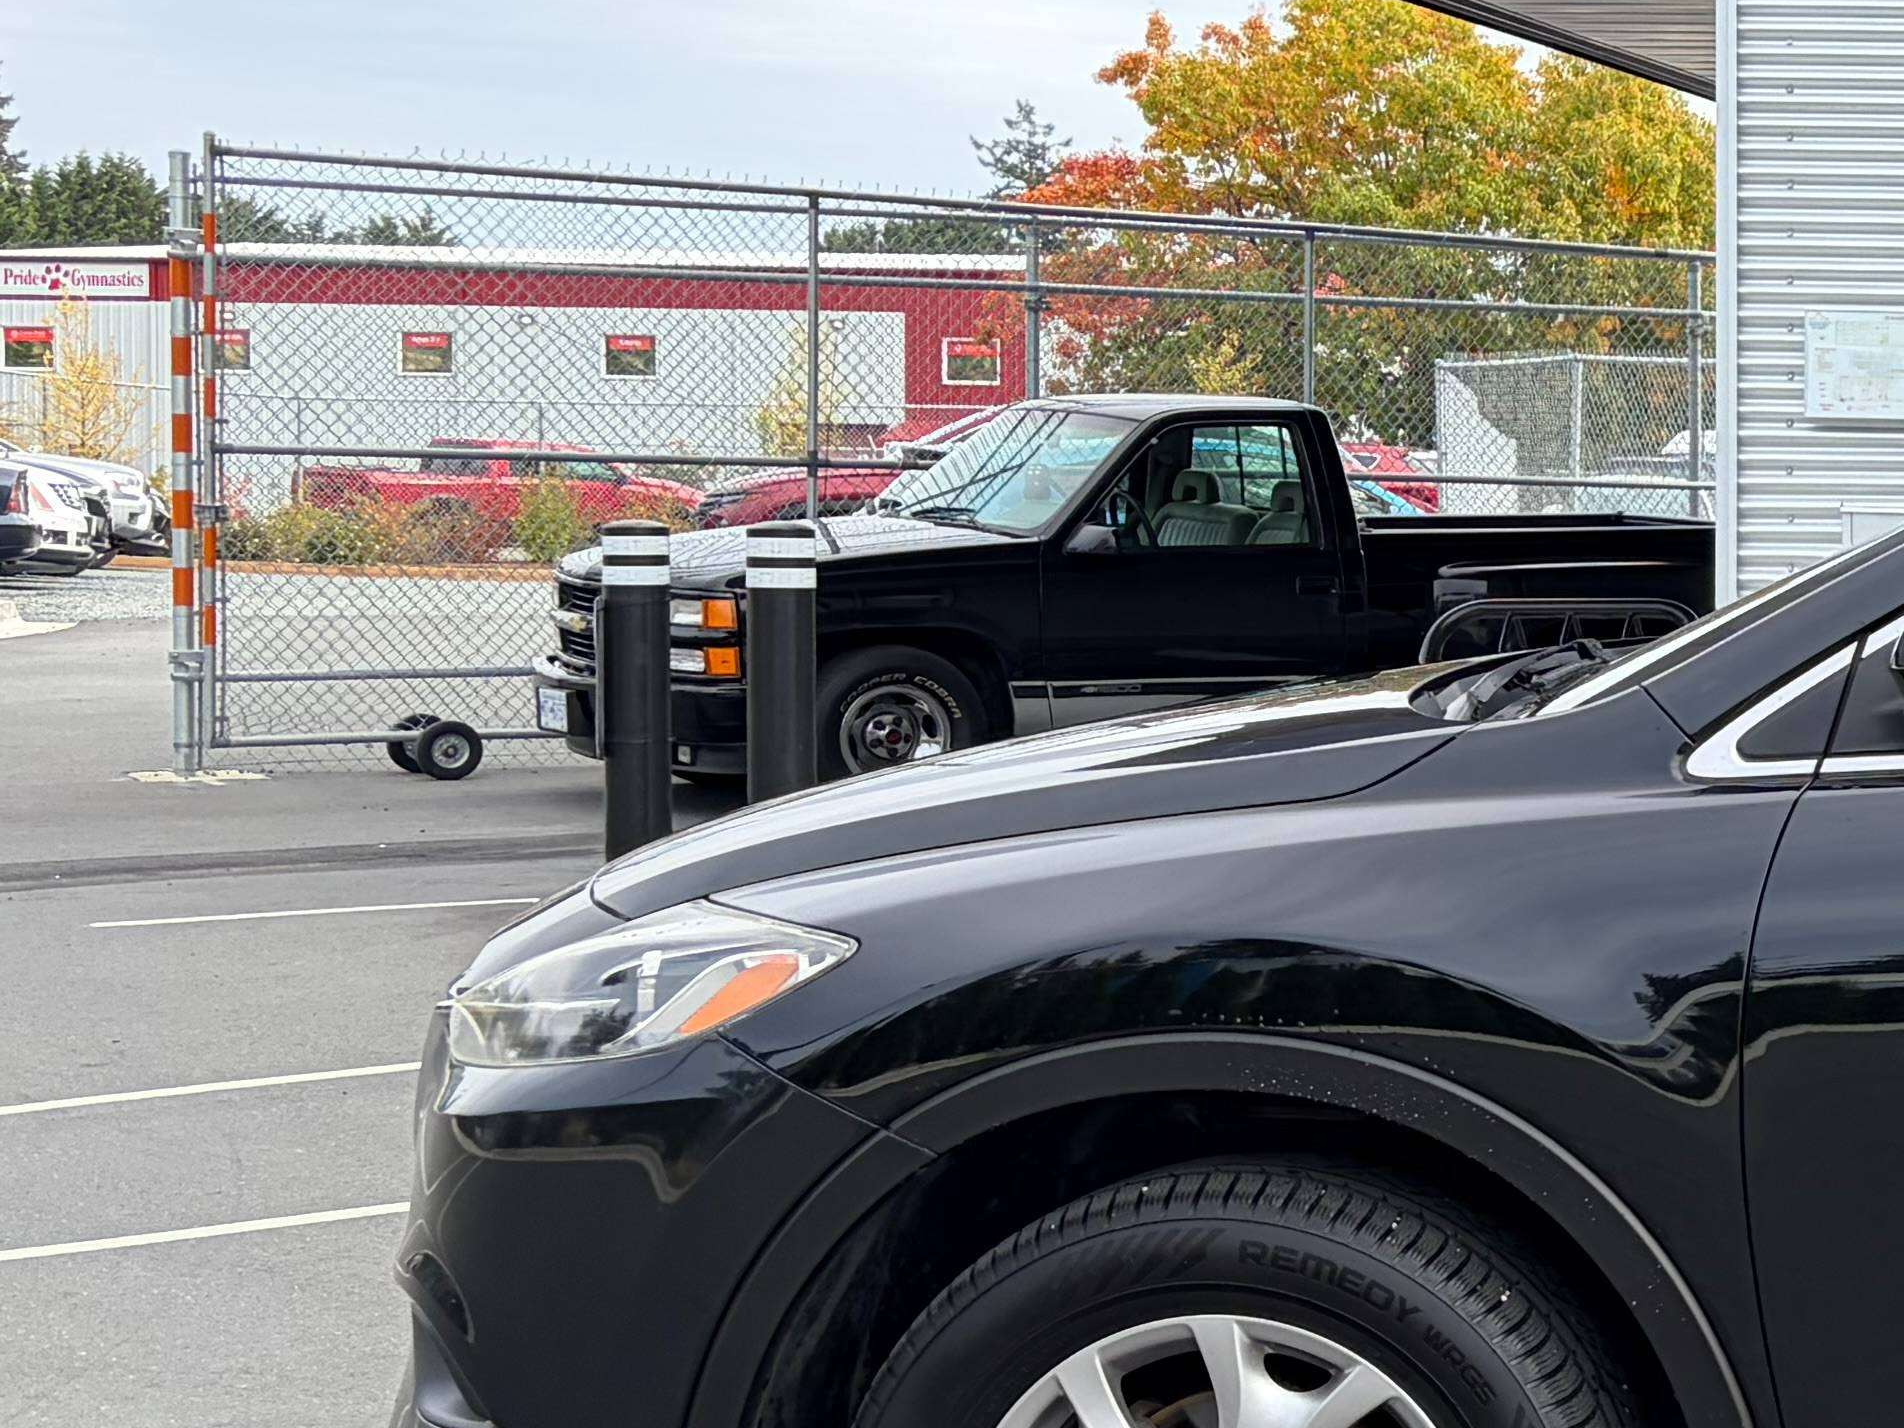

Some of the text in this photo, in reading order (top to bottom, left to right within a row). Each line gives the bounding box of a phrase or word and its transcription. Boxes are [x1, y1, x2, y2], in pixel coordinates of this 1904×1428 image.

[3, 267, 145, 291] Pride Gymnastics
[840, 673, 962, 719] COOPER COBRA
[1237, 1239, 1424, 1324] REMEDY
